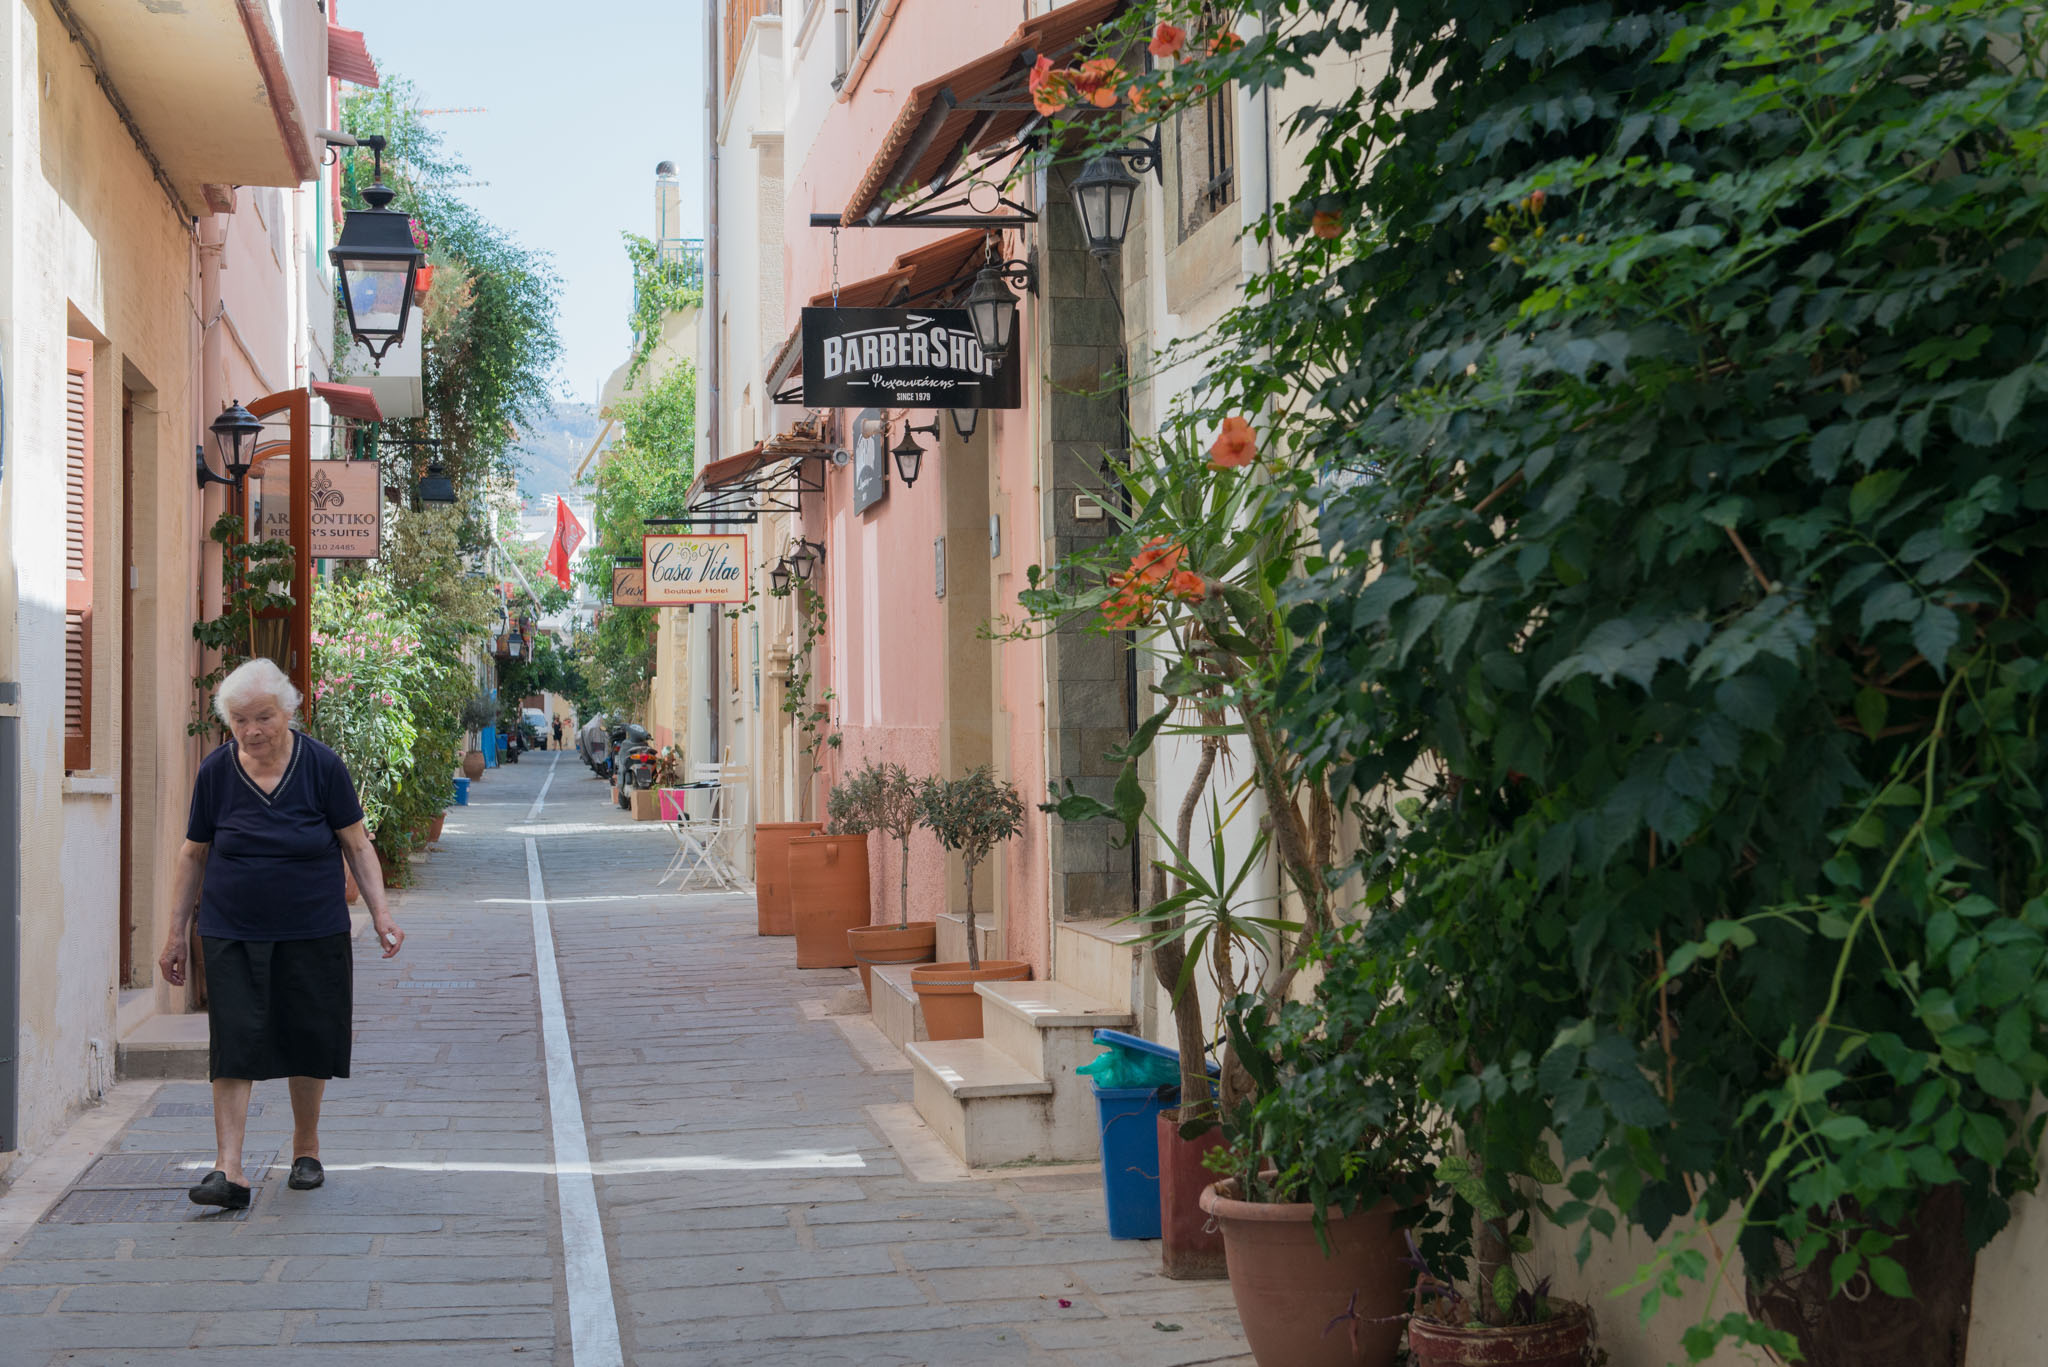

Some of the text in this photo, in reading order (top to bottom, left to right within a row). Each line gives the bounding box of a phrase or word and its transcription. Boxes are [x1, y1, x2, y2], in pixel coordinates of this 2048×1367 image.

[896, 392, 931, 401] SINCE 1979
[265, 512, 375, 525] ARONTIKO
[270, 528, 370, 537] RECR'S SUITES
[649, 542, 740, 583] Casa Vitae
